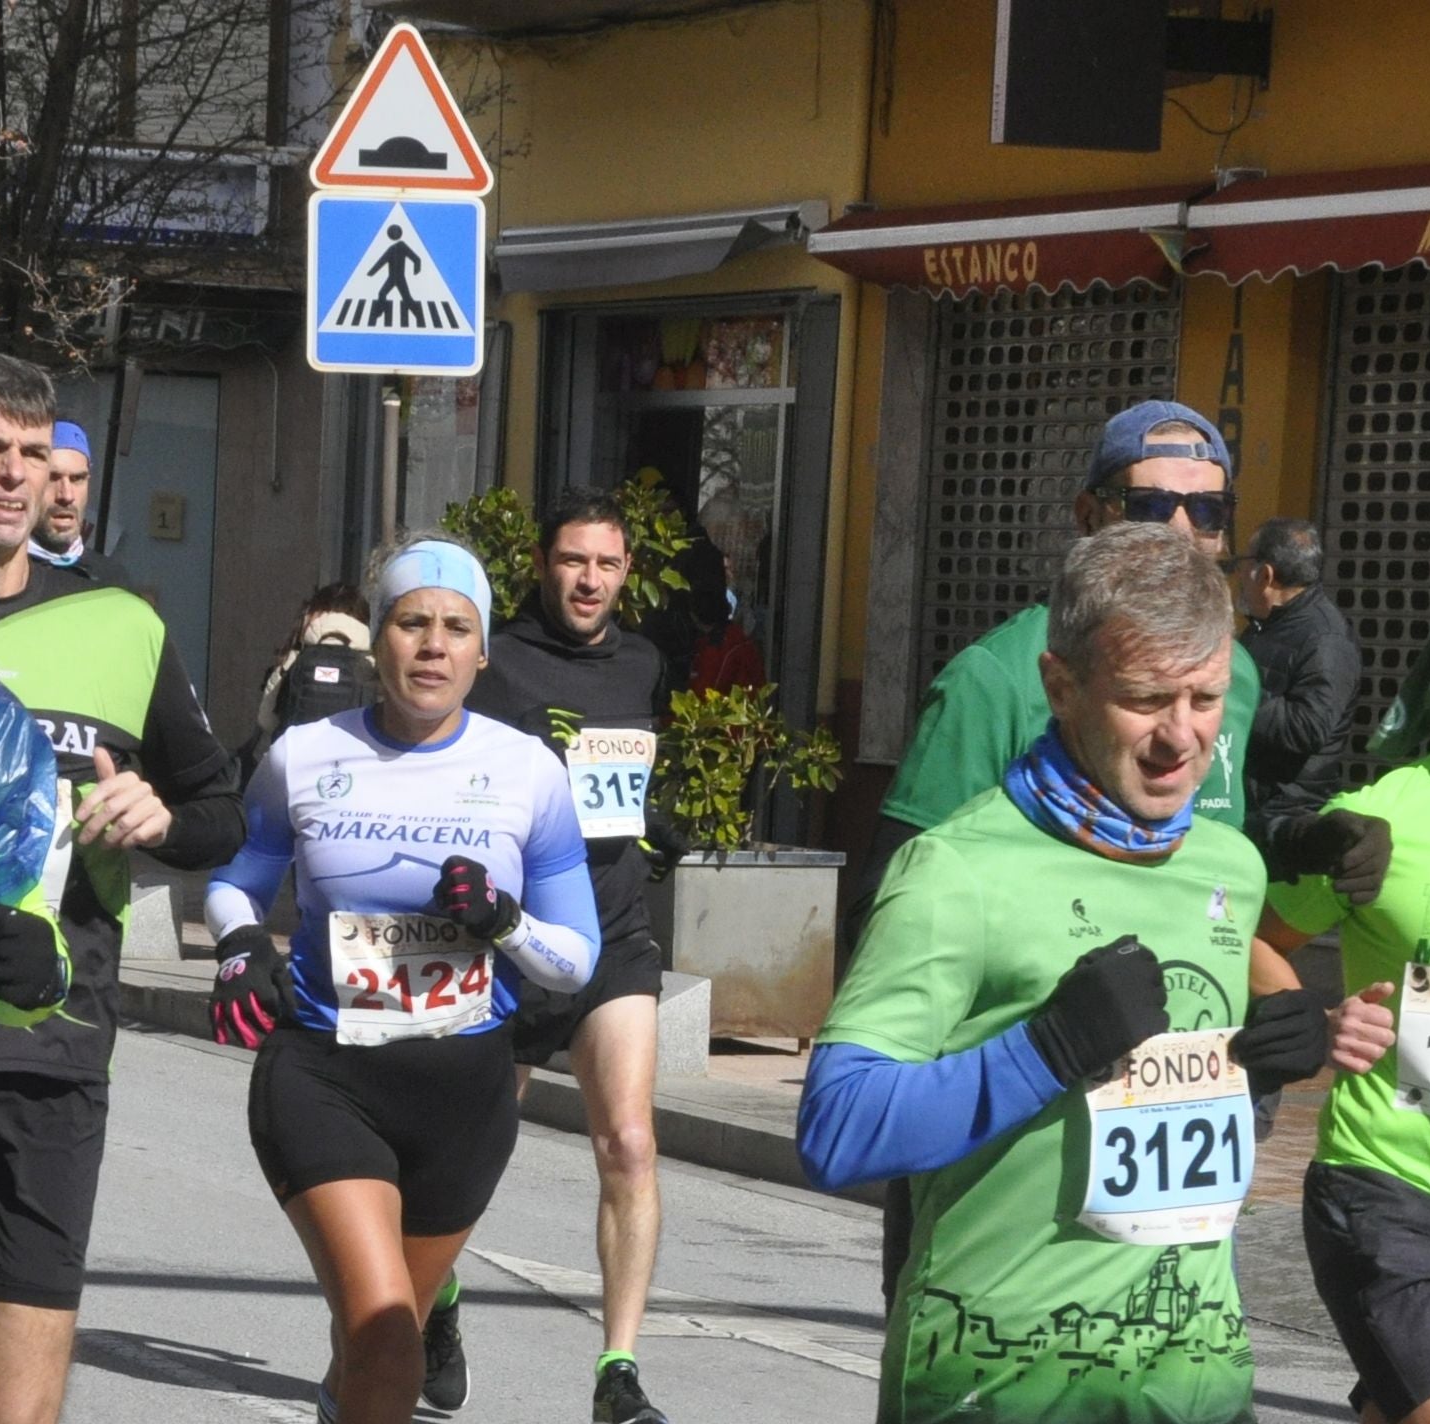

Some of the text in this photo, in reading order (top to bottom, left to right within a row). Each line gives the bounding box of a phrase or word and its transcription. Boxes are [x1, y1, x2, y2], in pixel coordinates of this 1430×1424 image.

[924, 241, 1038, 286] ESTANCO
[588, 739, 645, 756] FONDO
[339, 810, 471, 824] CLUB DE ATLETISMO
[319, 821, 492, 849] MARACENA
[371, 922, 459, 946] FONDO
[347, 952, 490, 1014] 2124
[1164, 972, 1210, 1000] OTEL
[1127, 1049, 1220, 1088] FONDO
[1103, 1114, 1241, 1198] 3121
